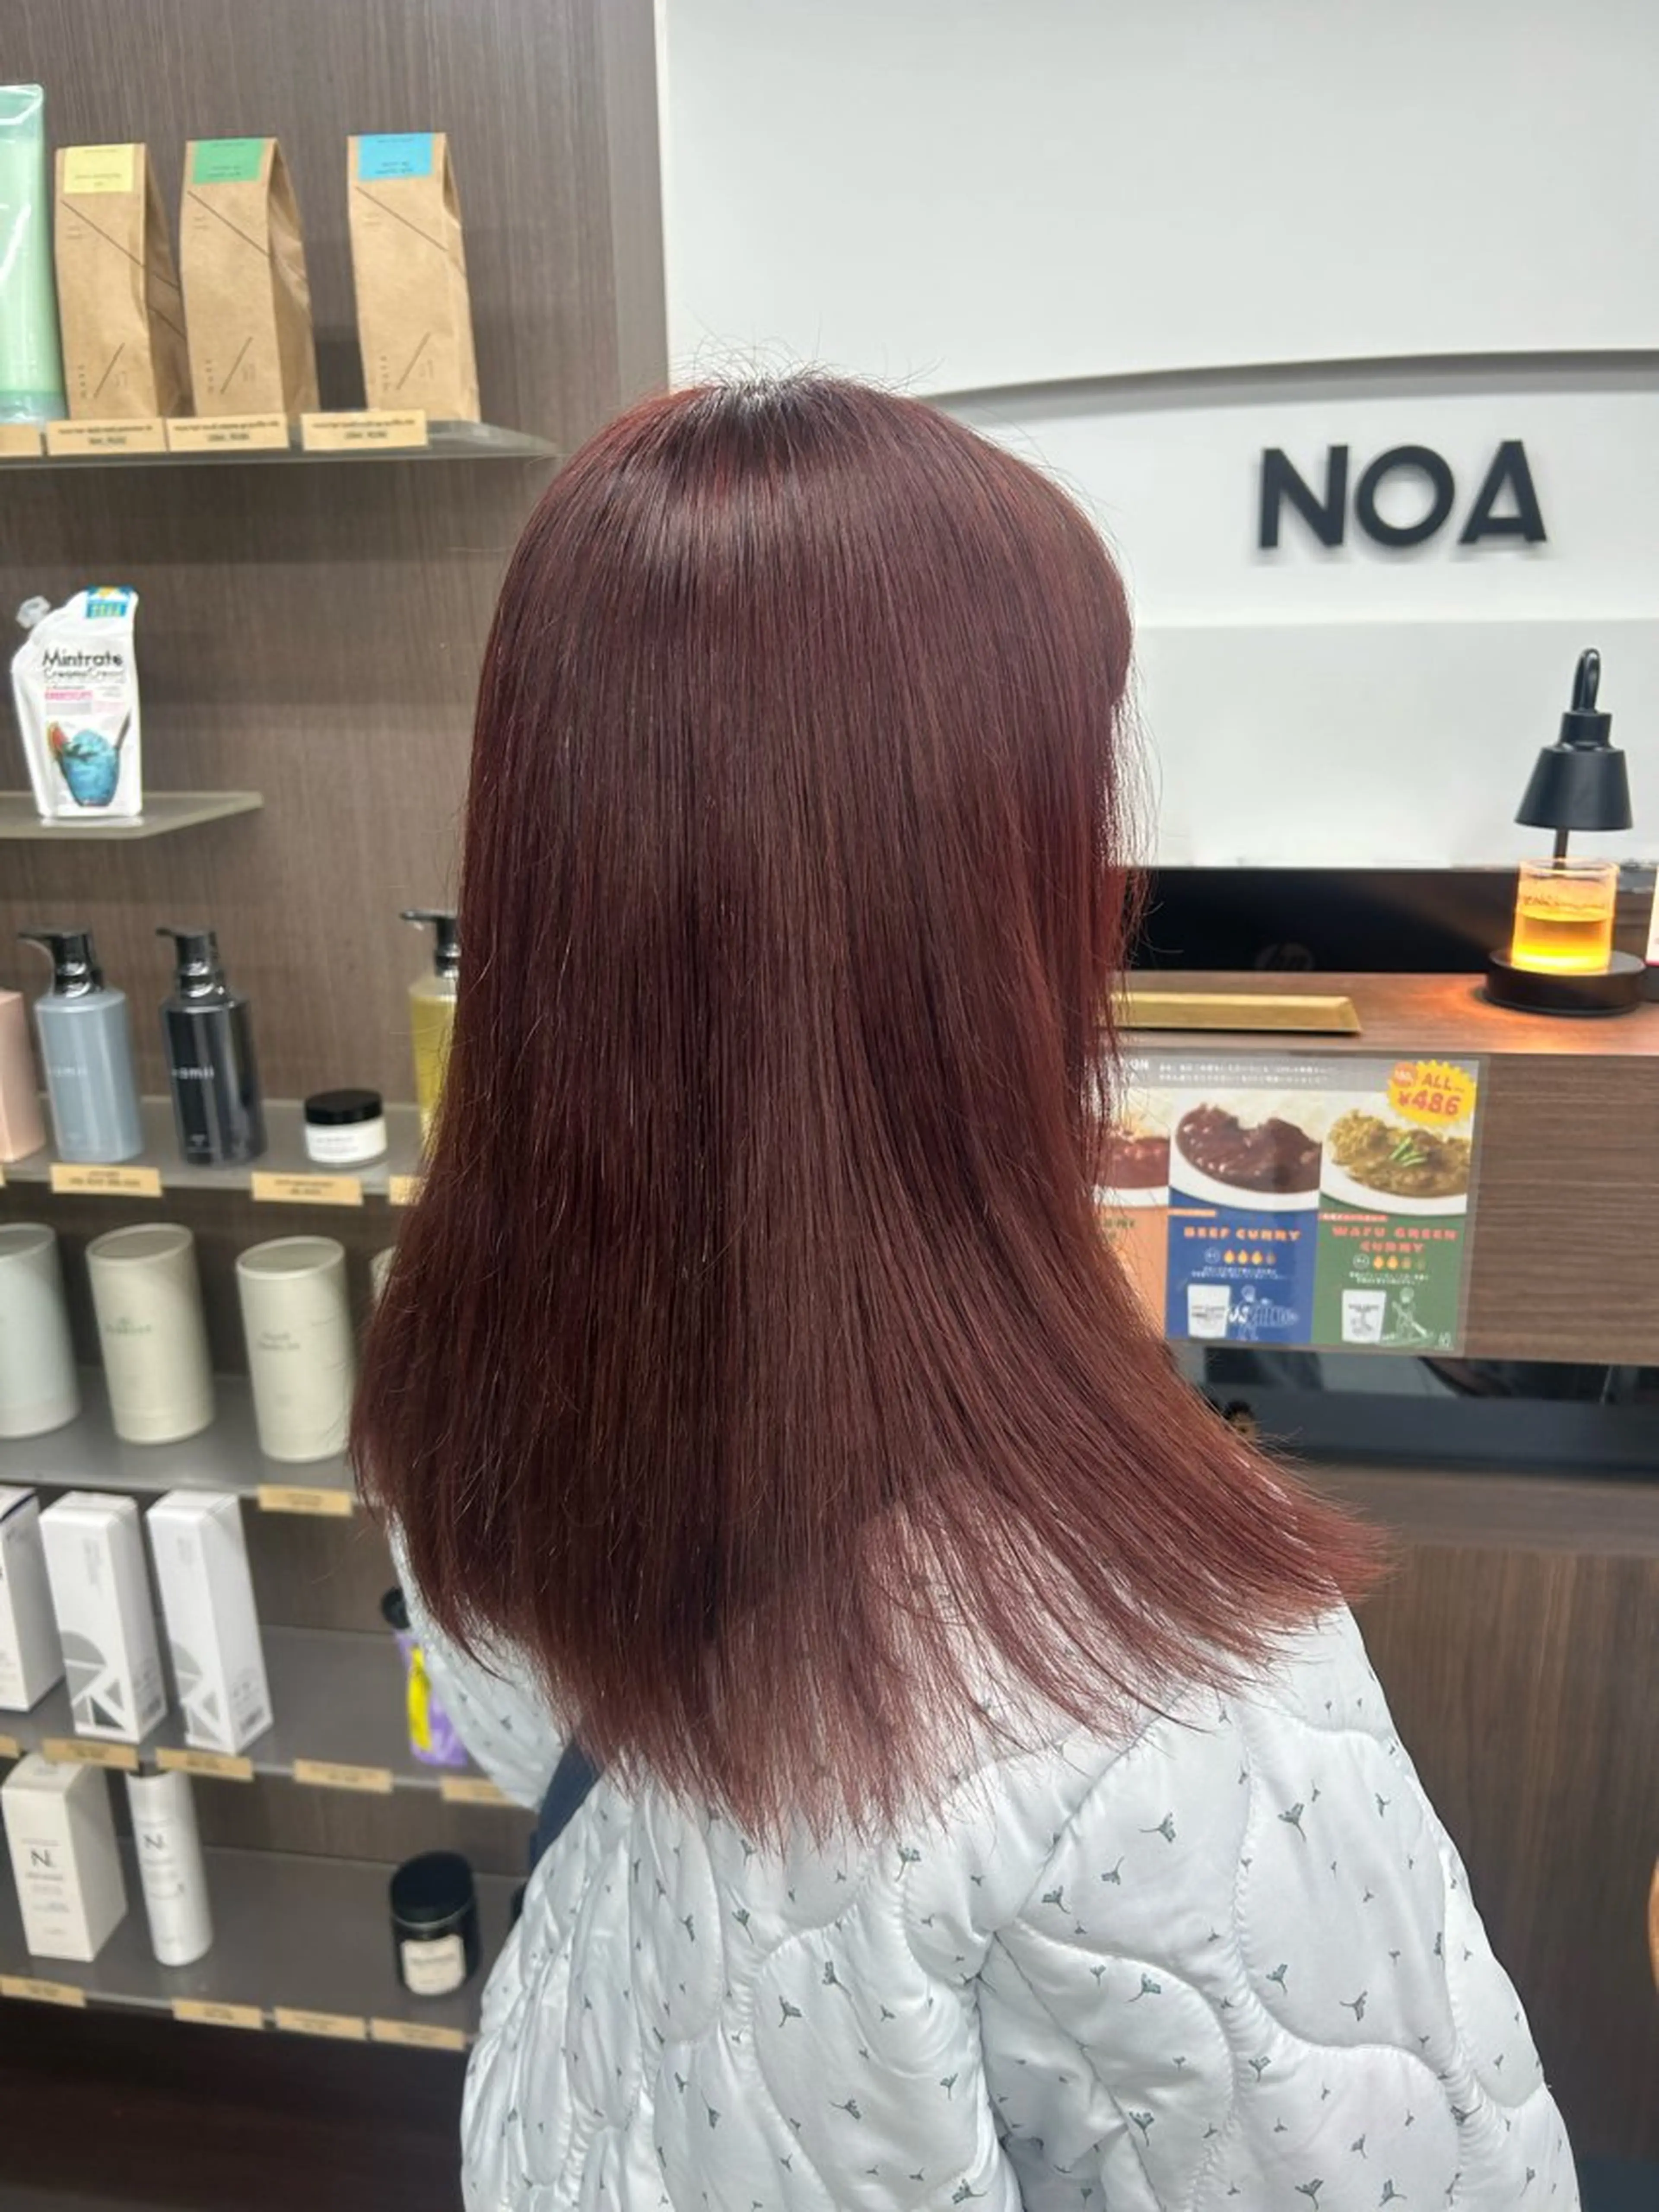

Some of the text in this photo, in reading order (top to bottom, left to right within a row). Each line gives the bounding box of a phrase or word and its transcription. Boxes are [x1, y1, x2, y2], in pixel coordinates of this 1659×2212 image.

[1259, 439, 1548, 548] NOA
[42, 647, 124, 667] Mintrate
[1183, 1226, 1300, 1241] BEEF CURRY
[1332, 1225, 1457, 1240] WAFU GREEN
[1360, 1240, 1423, 1253] CURRY
